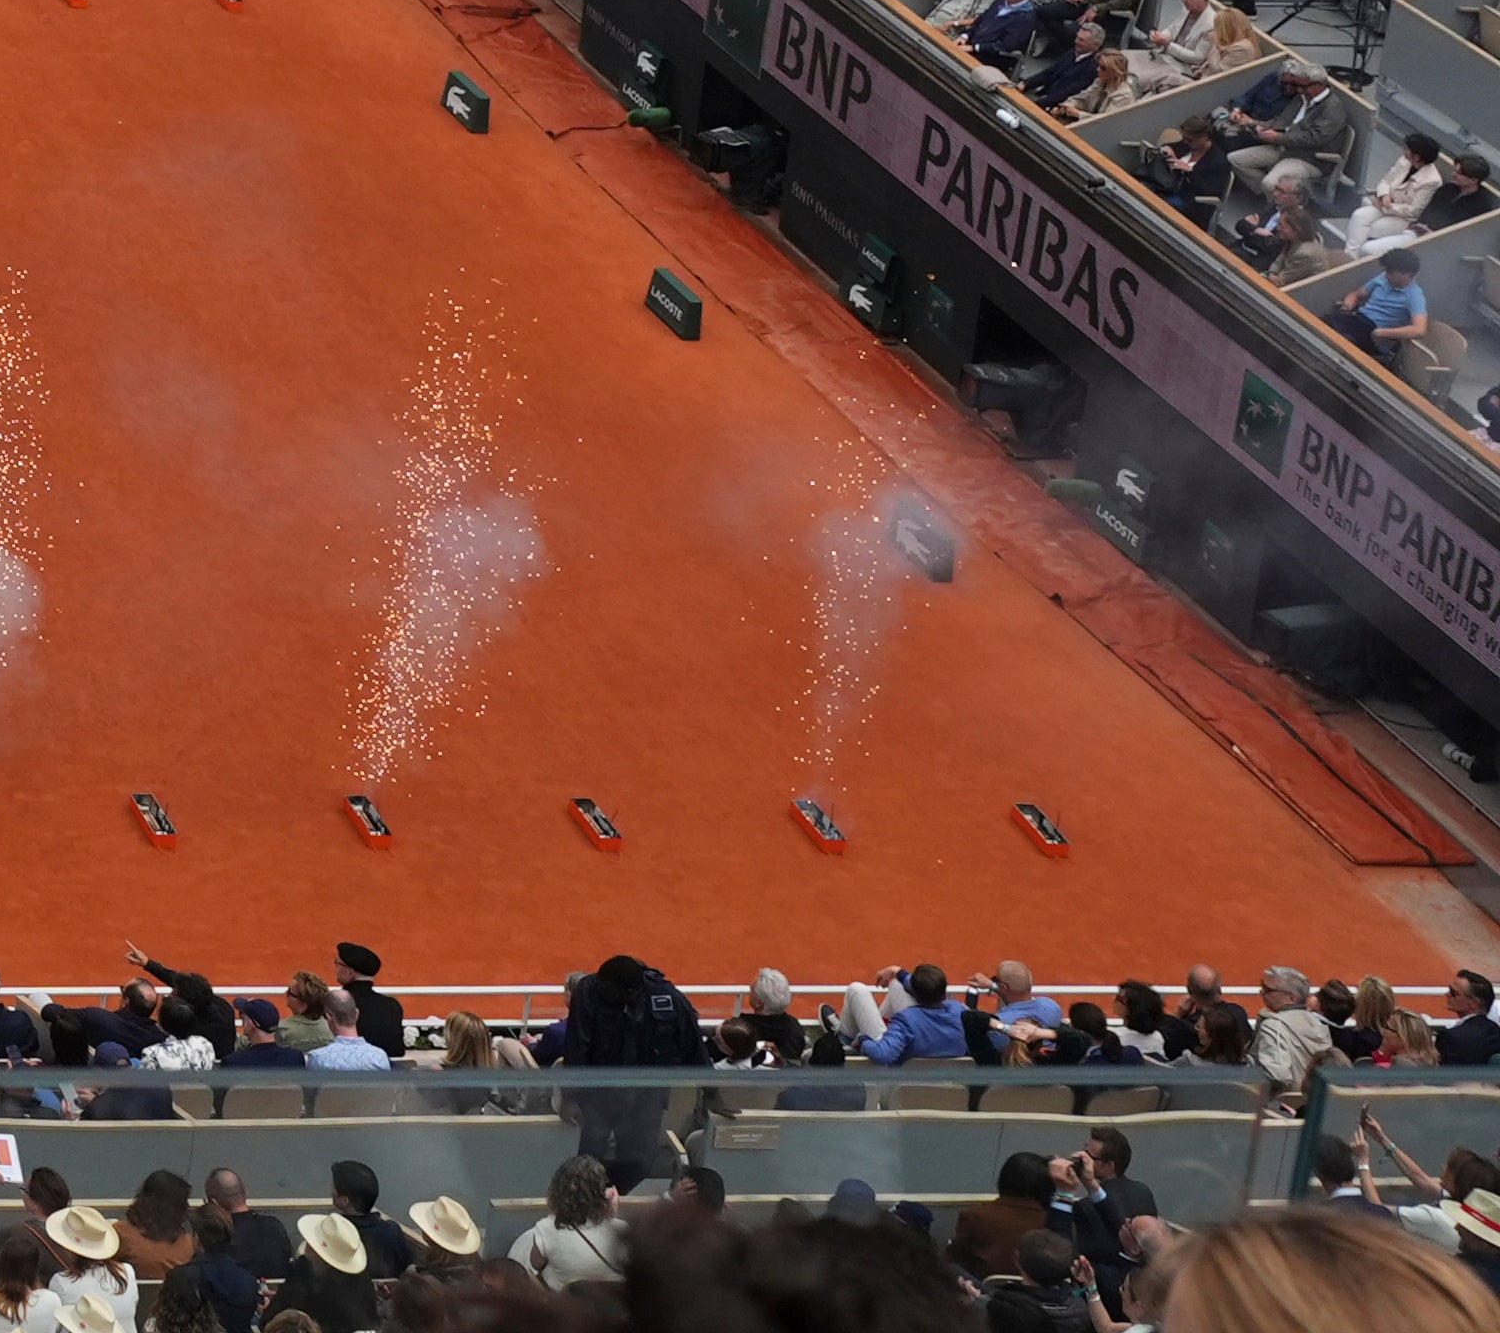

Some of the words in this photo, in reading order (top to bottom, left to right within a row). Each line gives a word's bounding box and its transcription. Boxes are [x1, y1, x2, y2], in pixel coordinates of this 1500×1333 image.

[775, 1, 872, 126] BNP
[916, 112, 1140, 353] PARIBAS
[861, 246, 886, 272] LACOSTE
[650, 284, 684, 322] LACOSTE
[1296, 422, 1376, 510] BNP
[1095, 502, 1140, 548] LACOSTE
[1295, 472, 1320, 510] The
[1324, 497, 1361, 543] bank
[1364, 532, 1389, 563] for
[1392, 557, 1402, 578] a
[1406, 568, 1482, 645] changing
